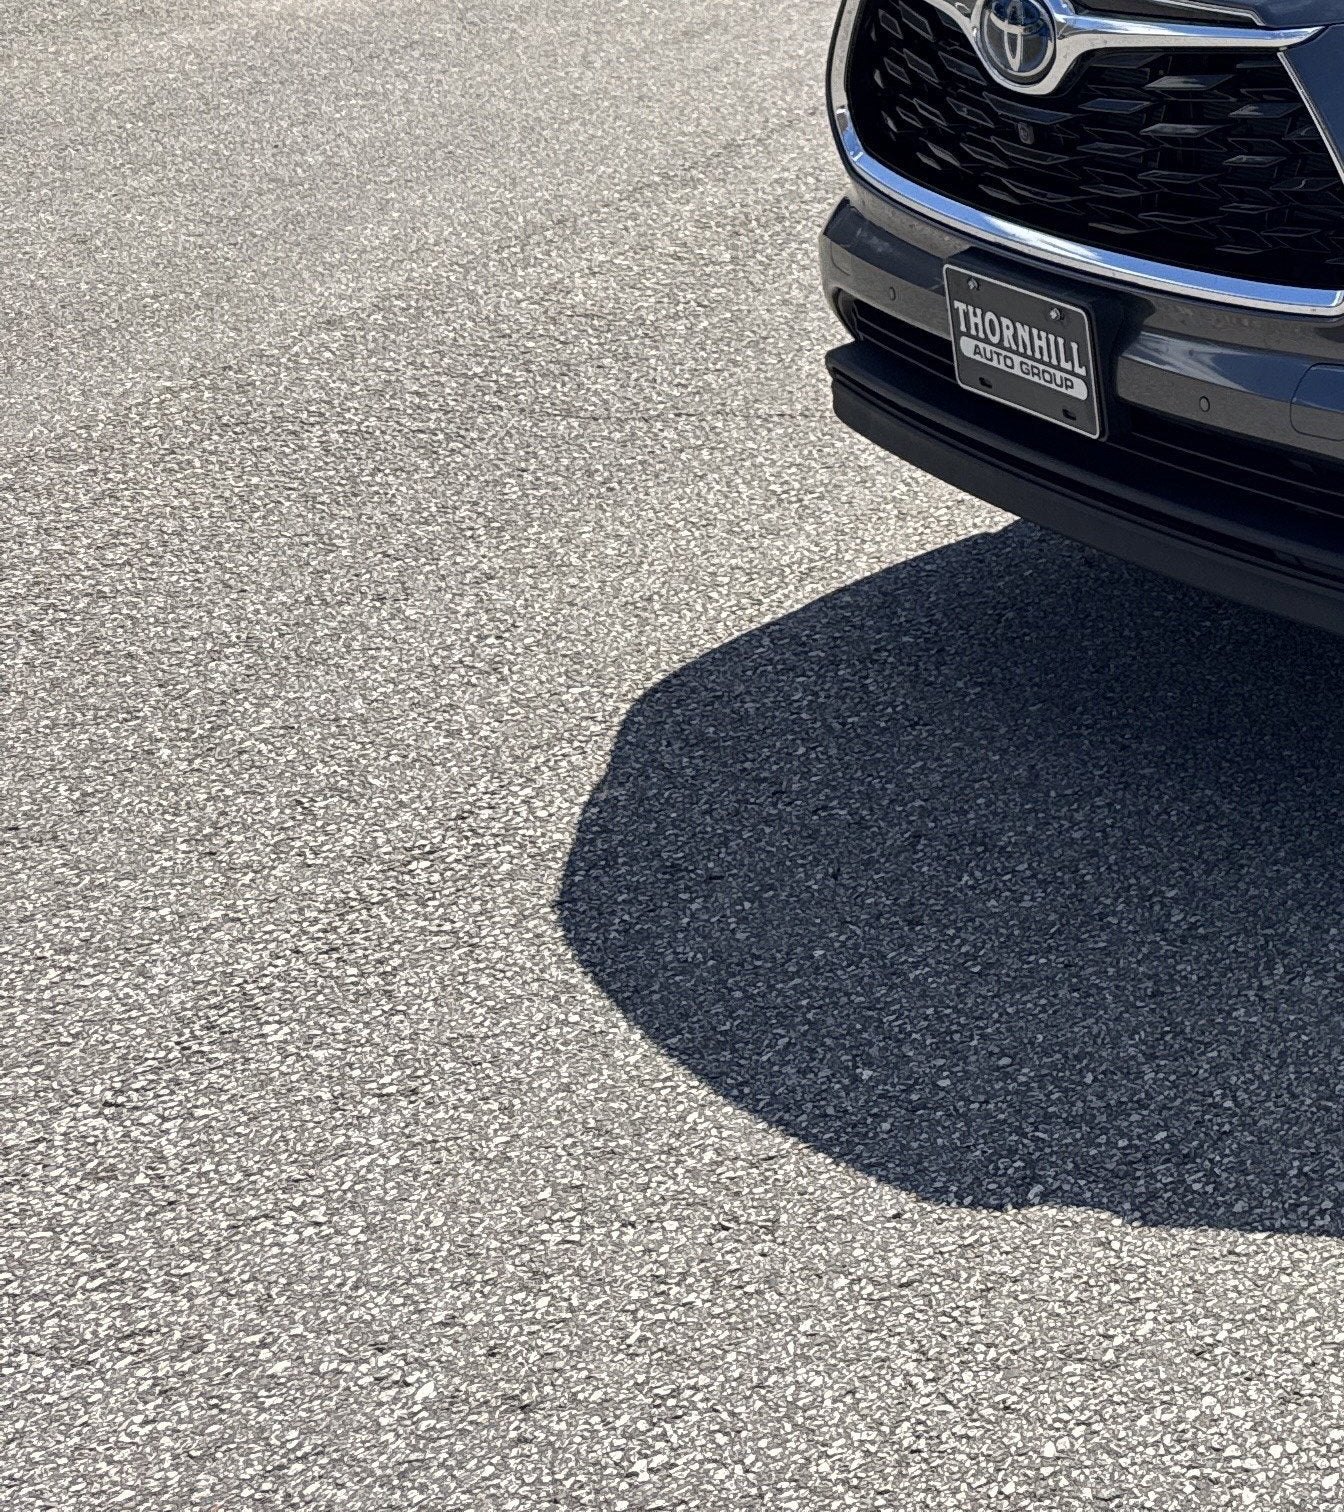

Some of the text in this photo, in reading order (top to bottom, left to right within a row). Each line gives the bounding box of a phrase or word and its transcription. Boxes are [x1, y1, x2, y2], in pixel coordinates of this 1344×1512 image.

[953, 300, 1087, 377] THORNHILL
[973, 343, 1075, 392] AUTO GROUP
